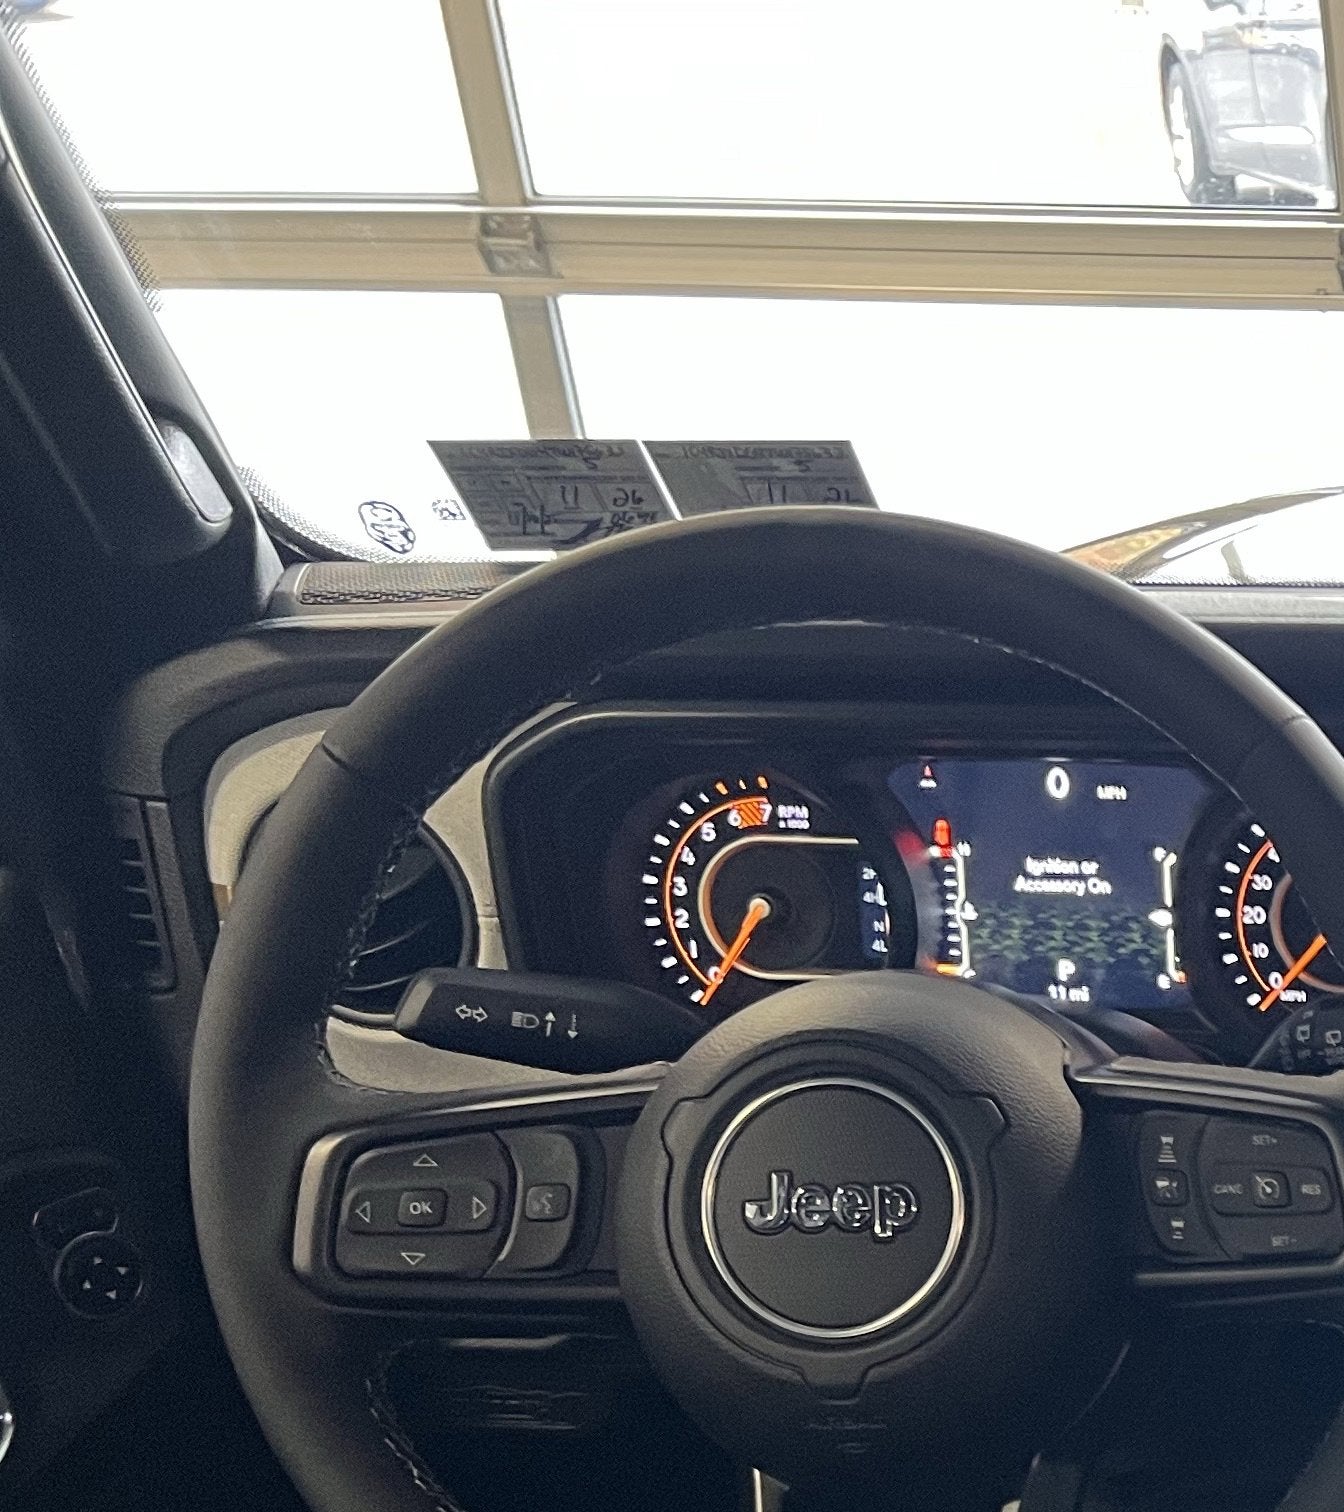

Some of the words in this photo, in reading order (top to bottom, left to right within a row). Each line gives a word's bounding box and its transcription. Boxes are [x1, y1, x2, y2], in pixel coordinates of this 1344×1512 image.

[1046, 766, 1070, 799] 0
[727, 809, 742, 827] 6
[760, 803, 773, 824] 7
[777, 804, 809, 820] RPM
[700, 822, 717, 842] 5
[681, 846, 696, 866] 4
[1025, 856, 1079, 877] Ignition
[1080, 860, 1100, 875] or
[672, 876, 689, 897] 3
[1013, 875, 1087, 897] Accessory
[1088, 878, 1113, 894] On
[1251, 873, 1273, 891] 30
[674, 908, 690, 929] 2
[1242, 904, 1267, 925] 20
[689, 938, 699, 959] 1
[1252, 942, 1270, 959] 10
[1057, 957, 1076, 982] P
[1268, 970, 1284, 990] 0
[1279, 988, 1307, 1003] MPH
[1301, 1184, 1321, 1195] RES
[408, 1201, 433, 1215] OK
[743, 1169, 922, 1242] Jeep
